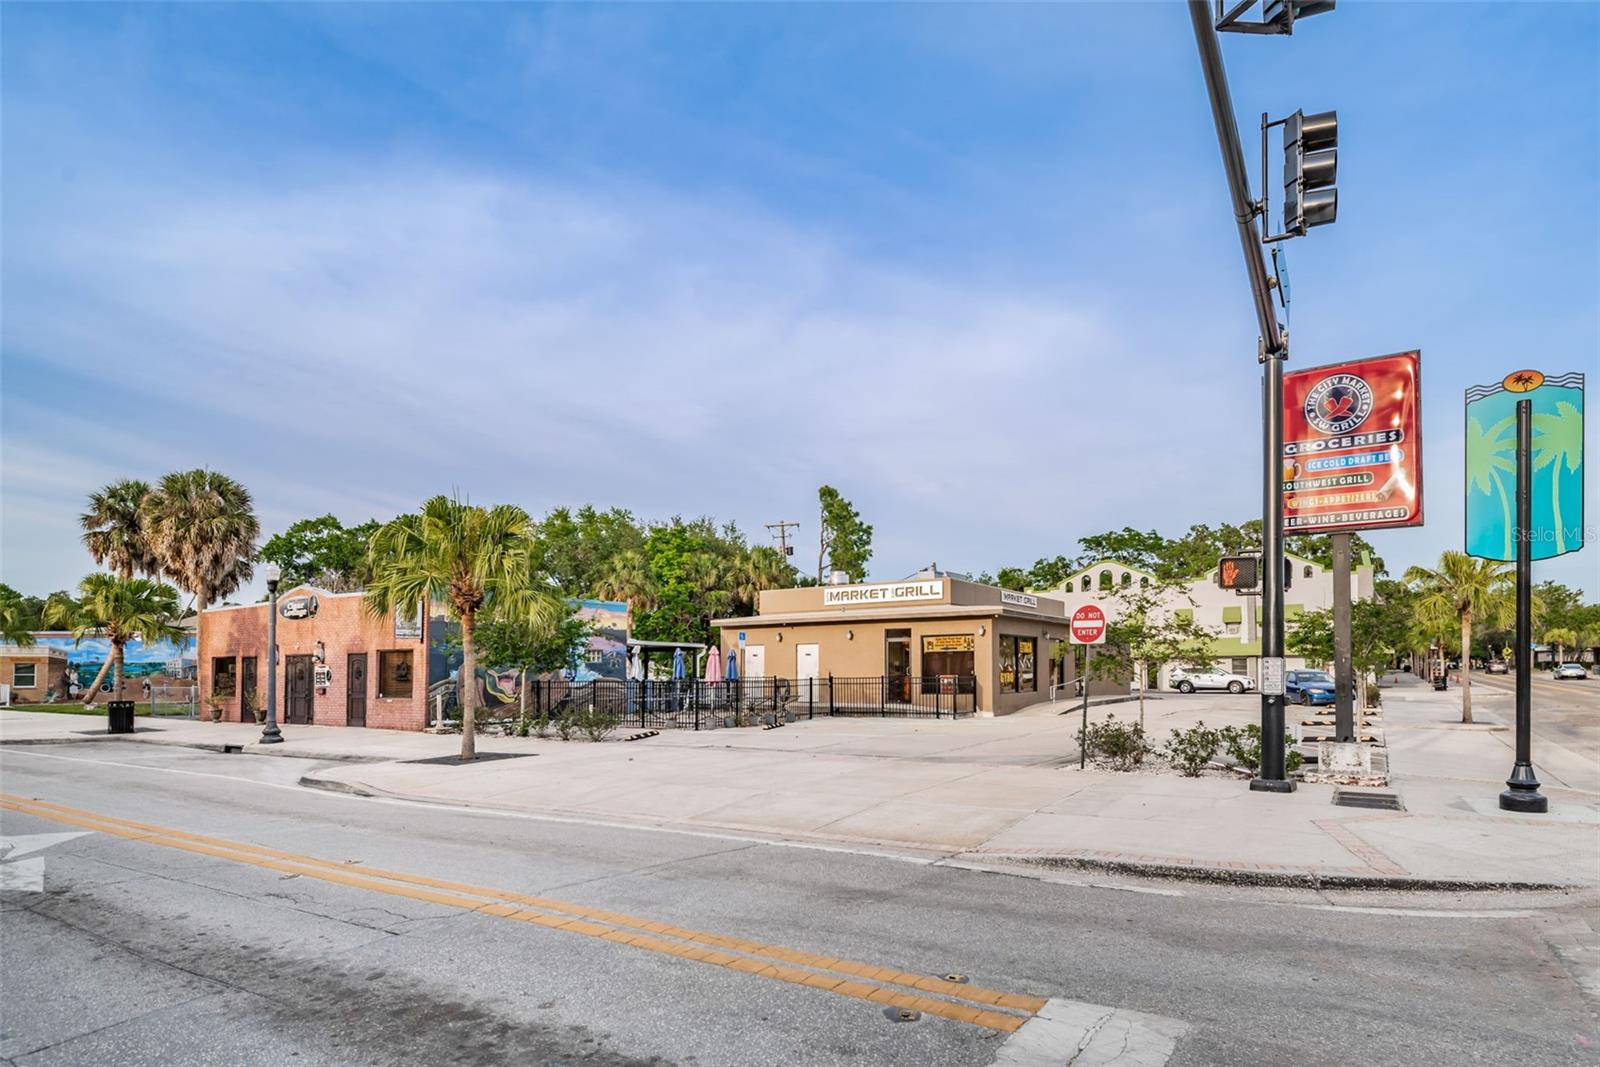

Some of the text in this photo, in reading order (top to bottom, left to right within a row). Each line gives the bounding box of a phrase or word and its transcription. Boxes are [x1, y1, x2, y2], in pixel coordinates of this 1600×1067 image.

[1307, 376, 1371, 411] THE CITY MARKET
[1313, 410, 1367, 432] SW GRILL
[1284, 431, 1398, 454] GROCERIES
[1307, 460, 1323, 470] ICE
[1323, 457, 1347, 468] COLD
[1348, 454, 1376, 465] DRAFT
[1339, 474, 1370, 485] GRILL
[830, 588, 889, 601] MARKET
[895, 585, 940, 597] GRILL
[1075, 611, 1101, 620] DO NOT
[1077, 628, 1098, 637] ENTER
